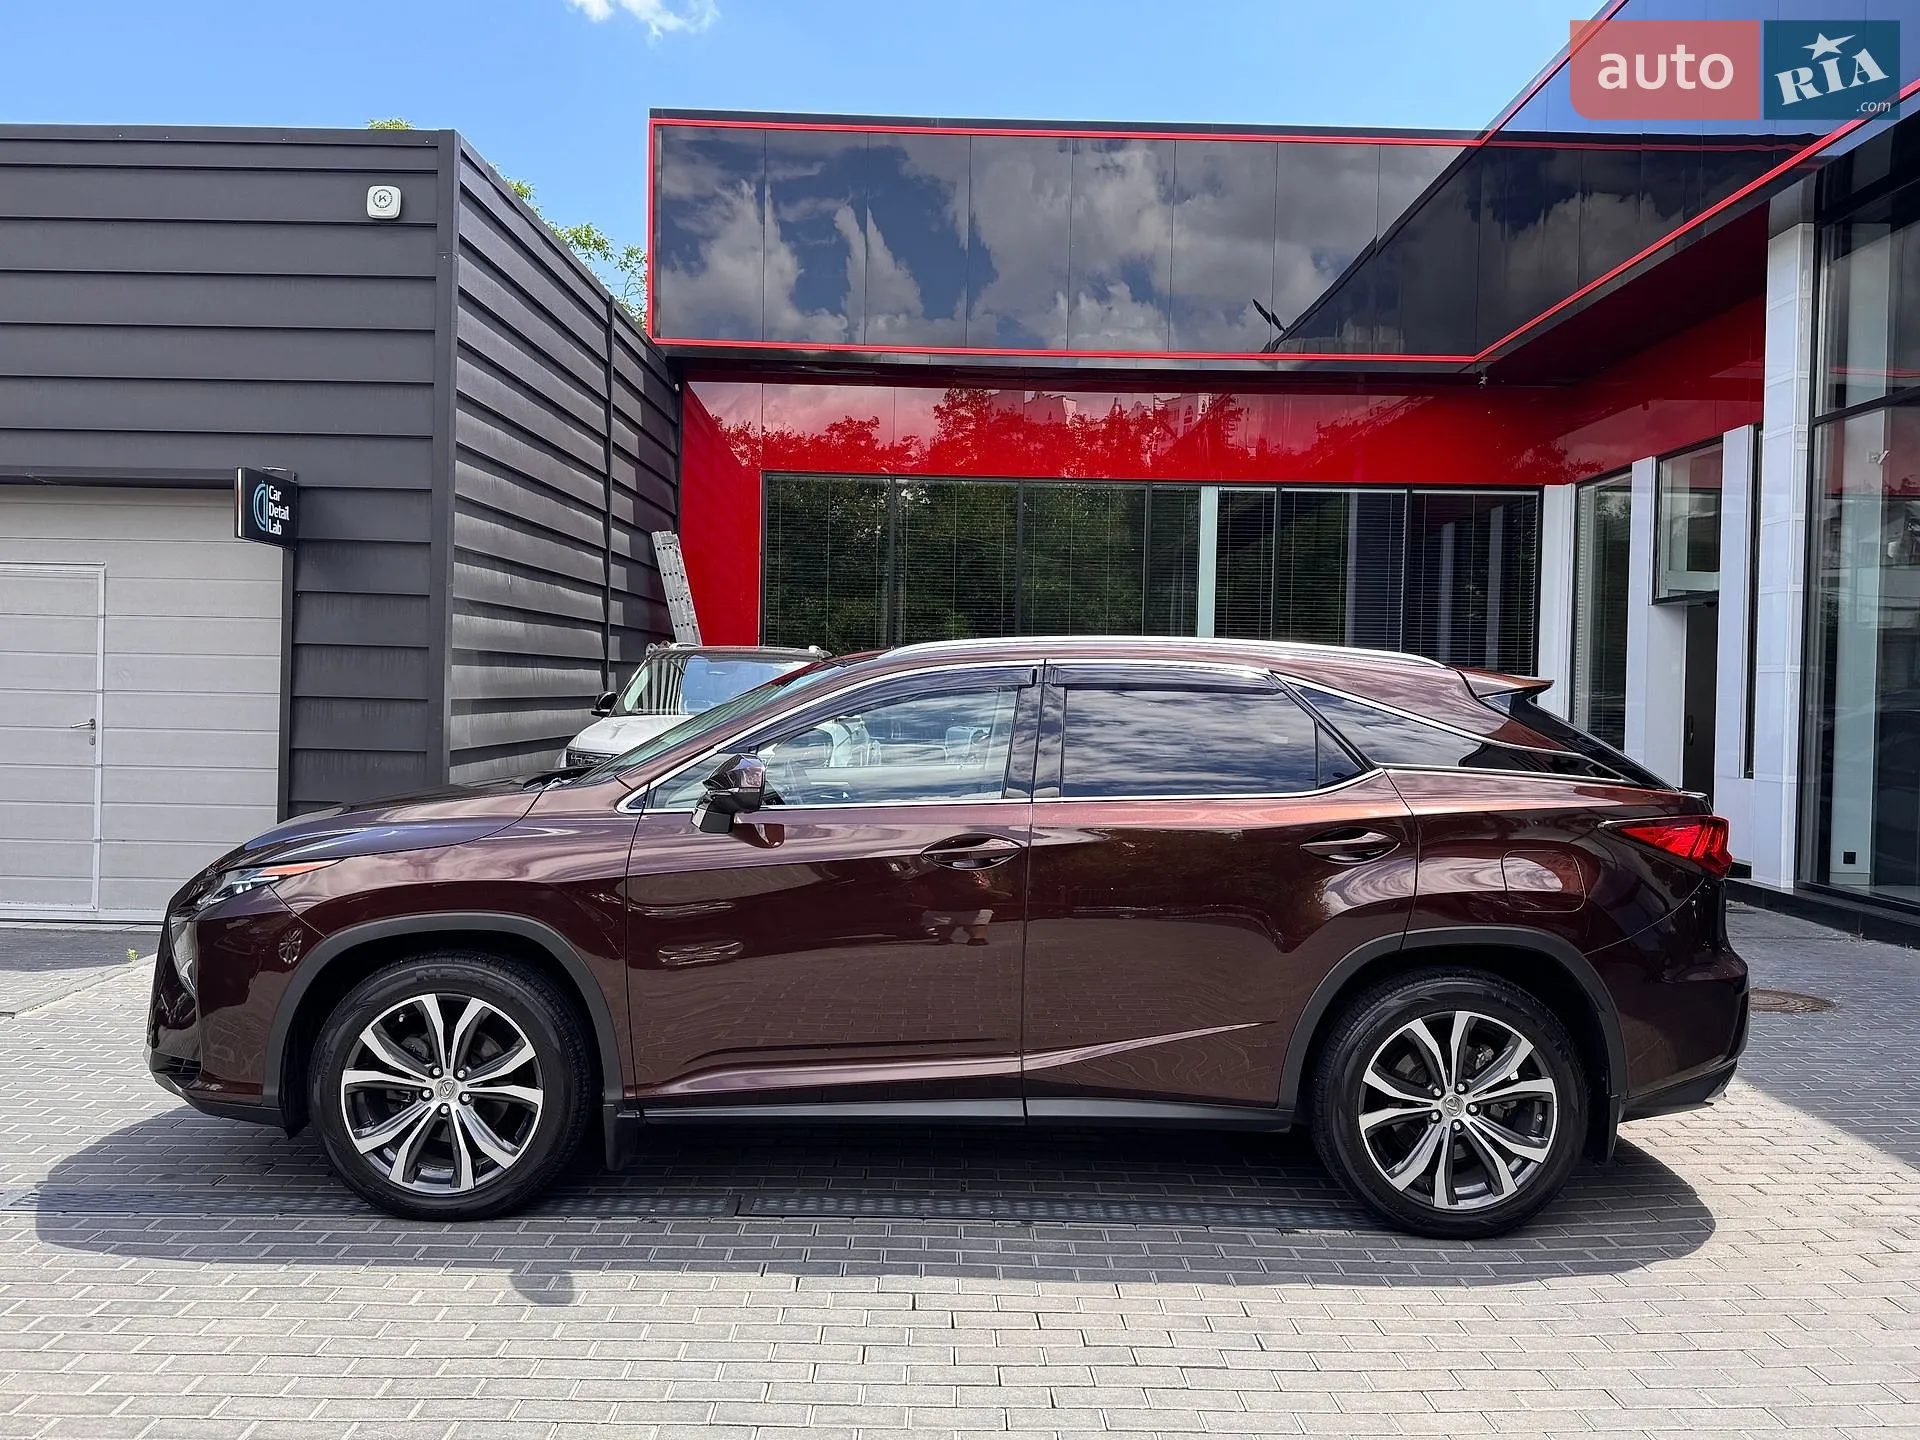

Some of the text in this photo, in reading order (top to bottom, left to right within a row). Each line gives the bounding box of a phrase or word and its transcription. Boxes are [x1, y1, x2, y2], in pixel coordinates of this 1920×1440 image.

[268, 485, 281, 501] Car
[268, 502, 289, 520] Detail
[268, 518, 282, 535] Lab
